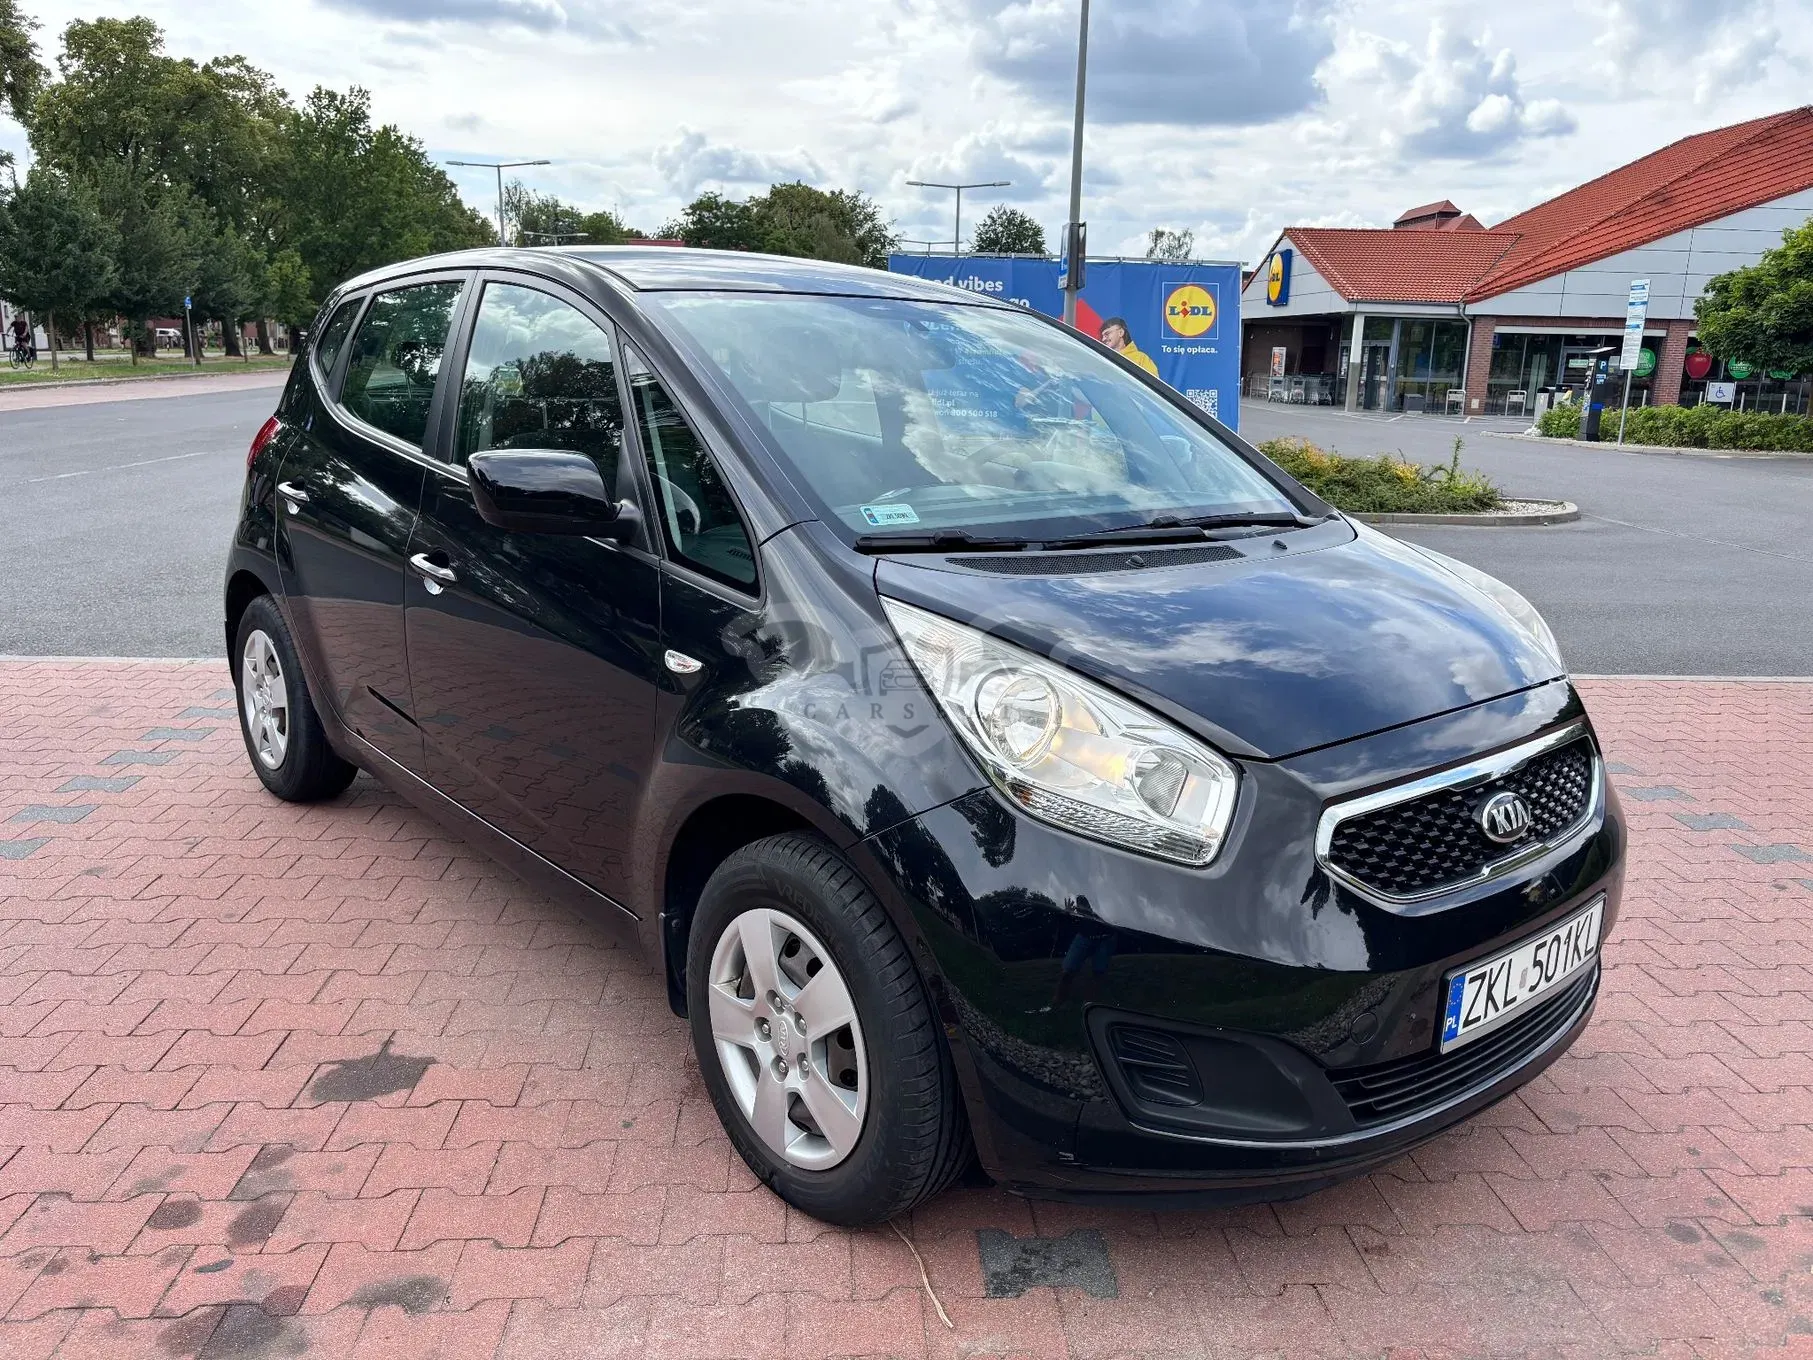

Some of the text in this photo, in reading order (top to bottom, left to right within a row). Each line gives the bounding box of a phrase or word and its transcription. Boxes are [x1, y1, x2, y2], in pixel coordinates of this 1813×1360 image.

[958, 275, 1004, 292] vibes
[1168, 301, 1212, 318] LIDL
[1161, 345, 1218, 355] To się opłaca.
[1490, 800, 1528, 835] KIA
[1462, 911, 1595, 1030] ZKL 501KL
[1445, 1017, 1458, 1032] PL
